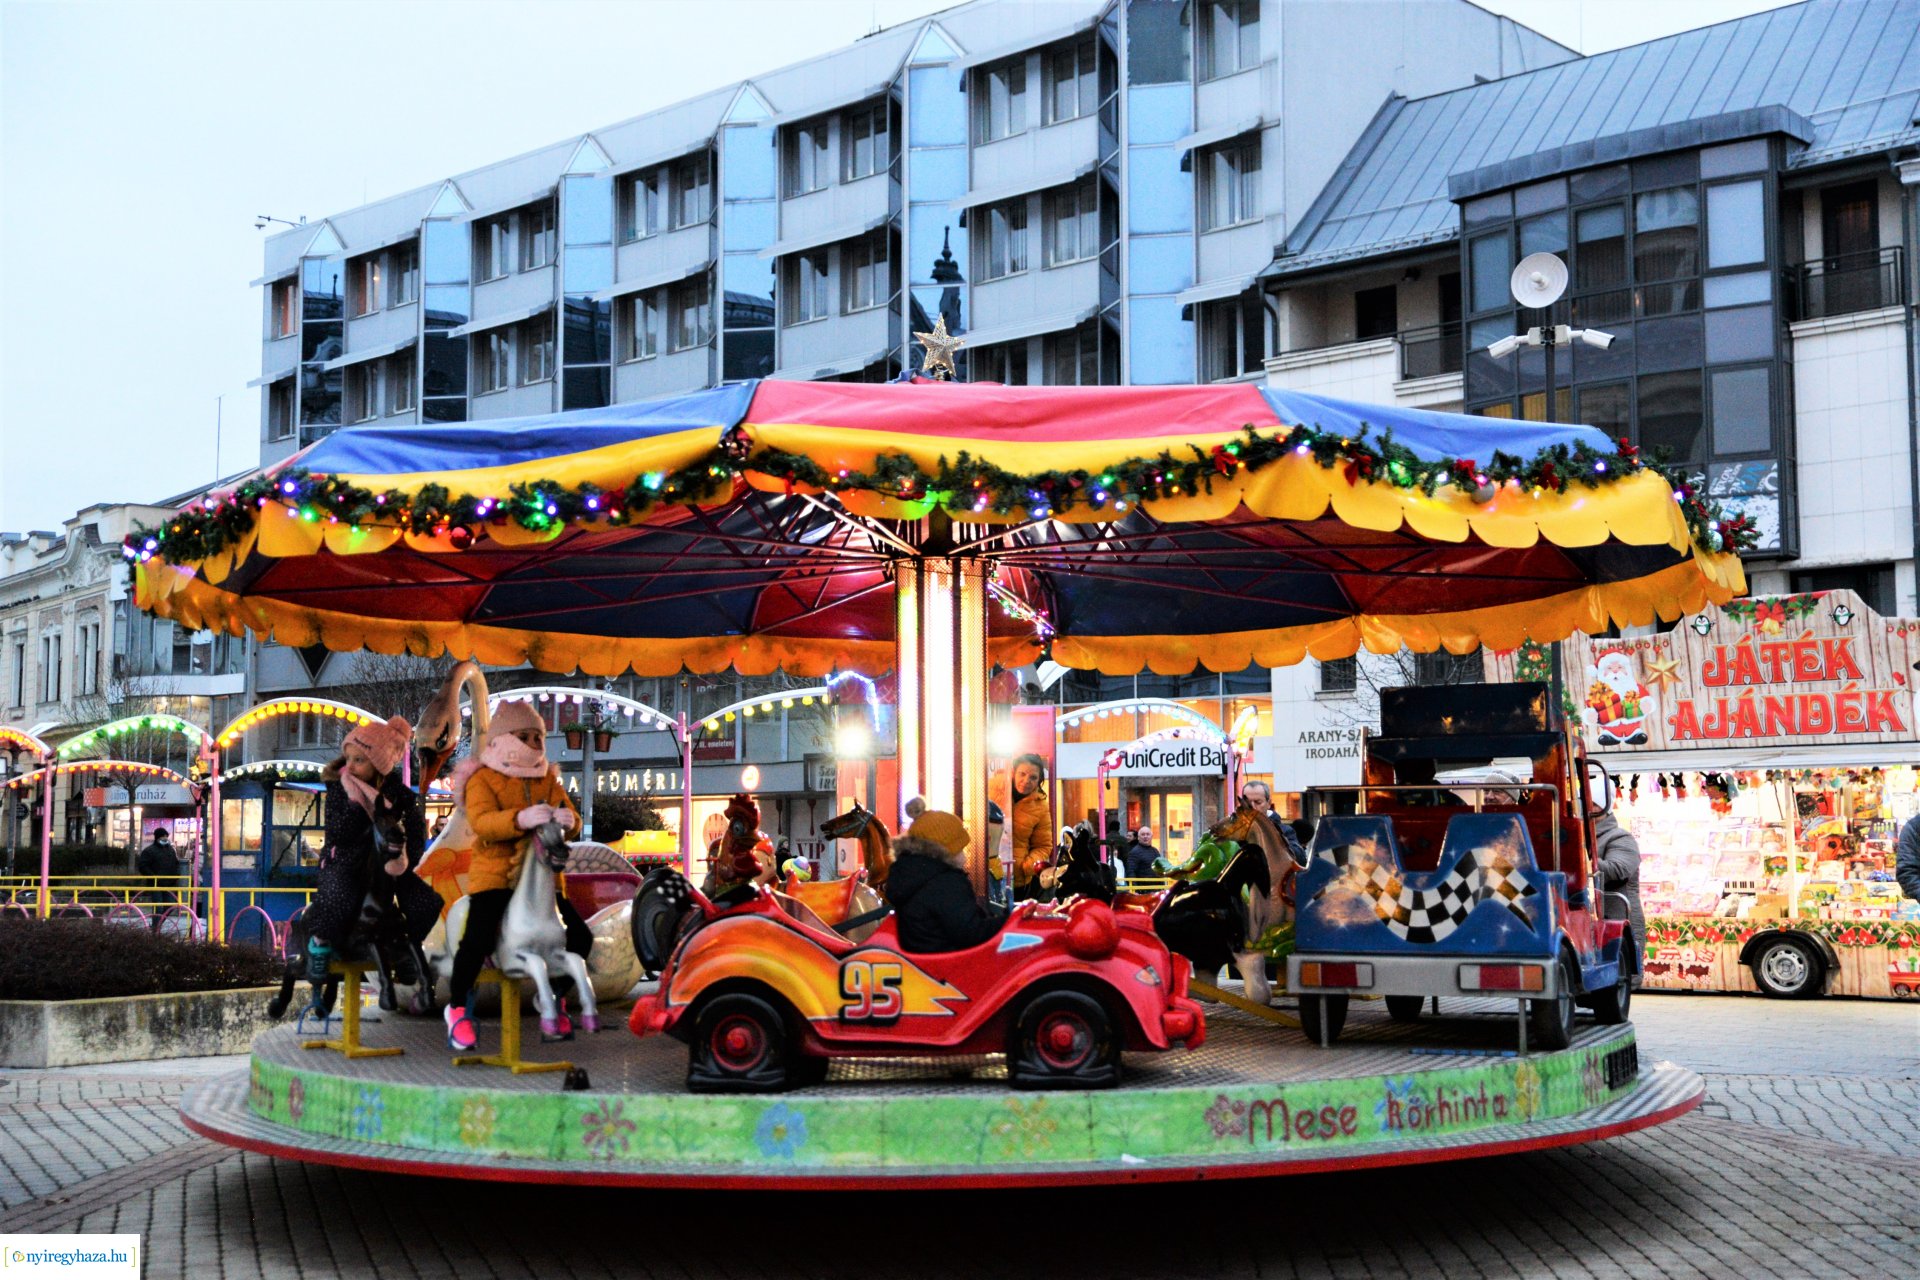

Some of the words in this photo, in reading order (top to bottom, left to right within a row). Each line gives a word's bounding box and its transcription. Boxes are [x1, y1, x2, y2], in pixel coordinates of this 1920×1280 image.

[1701, 629, 1864, 688] JÁTÉK
[1668, 683, 1907, 742] AJÁNDÉK
[1124, 747, 1196, 769] UniCredit
[796, 840, 825, 859] VIP
[840, 959, 902, 1021] 95
[1248, 1098, 1358, 1145] Mese
